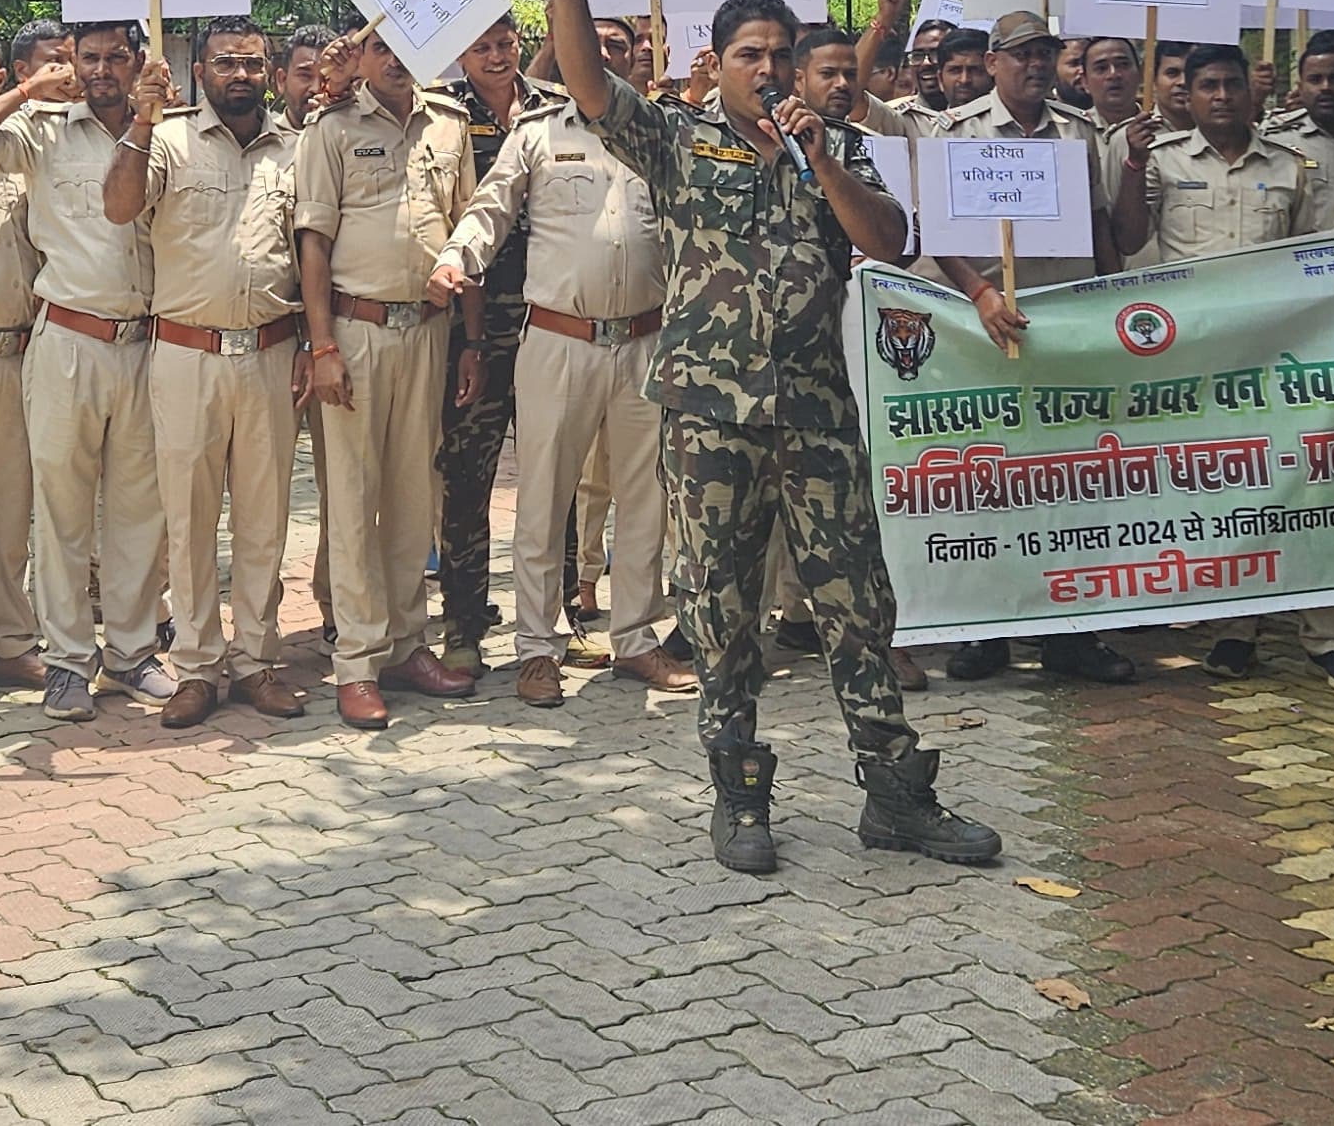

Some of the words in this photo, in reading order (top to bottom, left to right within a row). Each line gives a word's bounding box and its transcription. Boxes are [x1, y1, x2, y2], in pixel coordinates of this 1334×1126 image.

[432, 1, 450, 23] भर्ती
[980, 145, 1024, 159] खैरियत
[962, 169, 1013, 181] प्रतिवेदन
[988, 189, 1022, 203] चलतो
[1303, 264, 1324, 276] सेवा
[883, 385, 1022, 437] झारखण्ड
[1032, 385, 1115, 425] राज्य
[1126, 376, 1203, 418] अवर
[1212, 366, 1267, 410] वन
[884, 433, 1159, 517] अनिश्चितकालीन
[1162, 436, 1270, 493] धरना
[1279, 454, 1295, 466] -
[925, 534, 998, 563] दिनांक
[1017, 532, 1040, 556] 16
[1049, 524, 1111, 553] अगस्त
[1118, 521, 1176, 547] 2024
[1182, 511, 1204, 542] से
[1043, 549, 1282, 604] हजारीबाग
